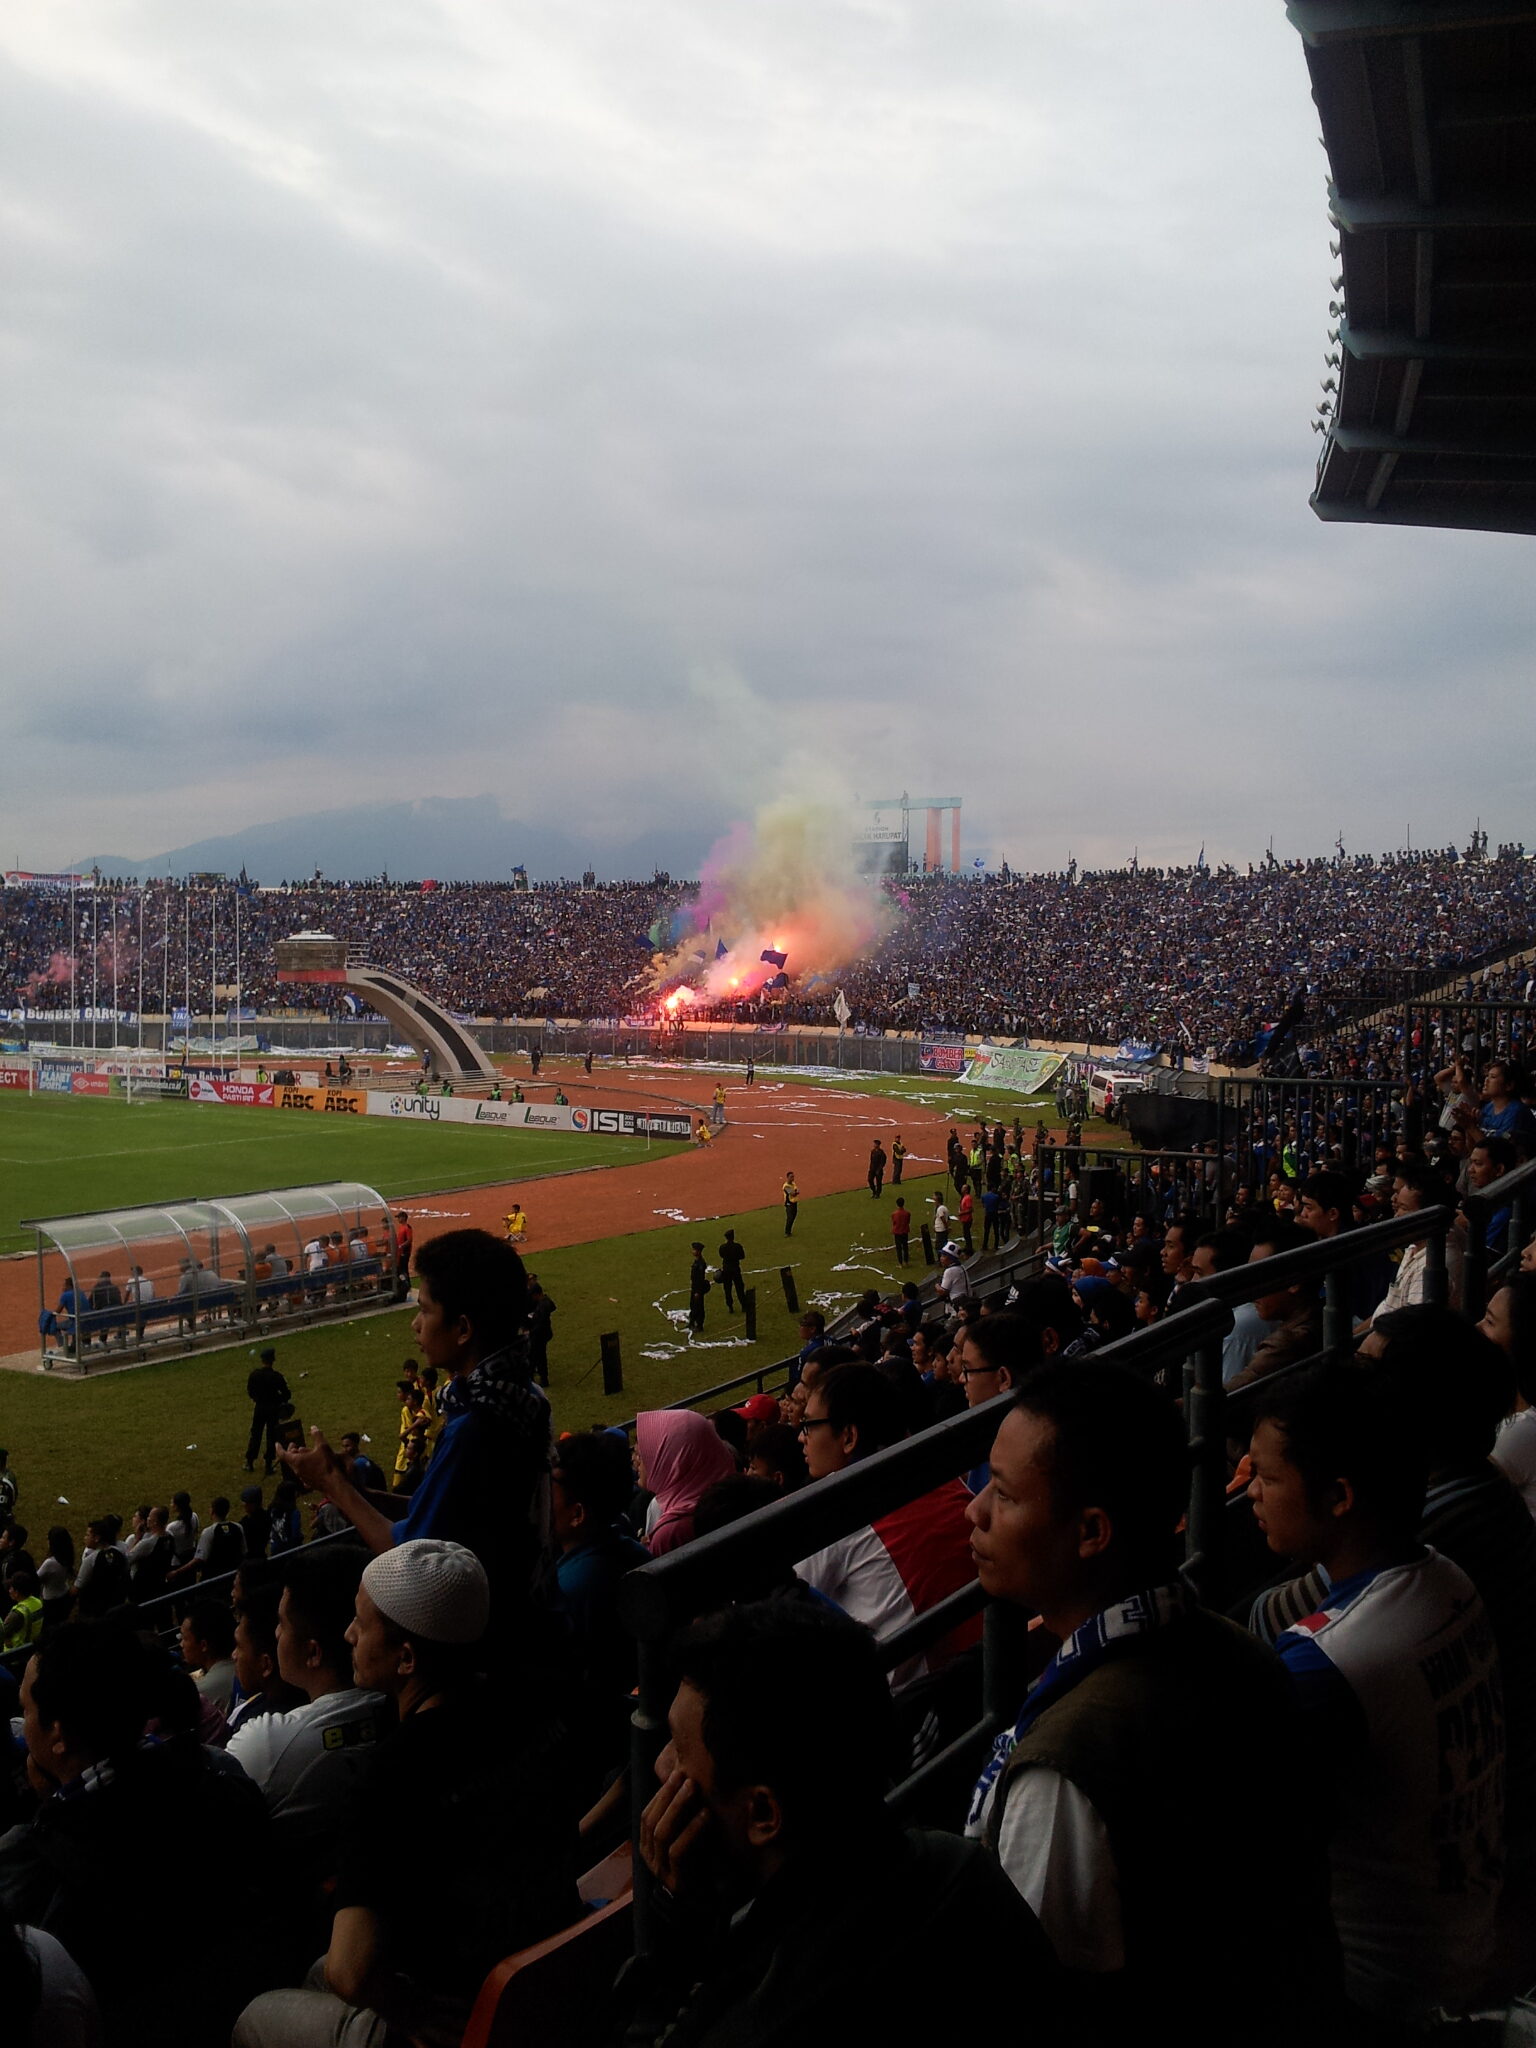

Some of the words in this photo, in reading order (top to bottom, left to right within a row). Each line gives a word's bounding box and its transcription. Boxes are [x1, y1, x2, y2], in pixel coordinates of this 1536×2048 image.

[27, 1008, 81, 1020] BOMBER
[932, 1047, 964, 1060] BOMBER
[40, 1071, 71, 1082] PLANET
[222, 1084, 254, 1095] HONDA
[327, 1089, 342, 1097] KOPI
[222, 1093, 241, 1102] PASTI
[281, 1093, 315, 1109] ABC
[324, 1096, 359, 1113] ABC
[403, 1096, 440, 1121] unity
[475, 1103, 508, 1121] League
[524, 1106, 557, 1124] League
[592, 1111, 635, 1133] ISL
